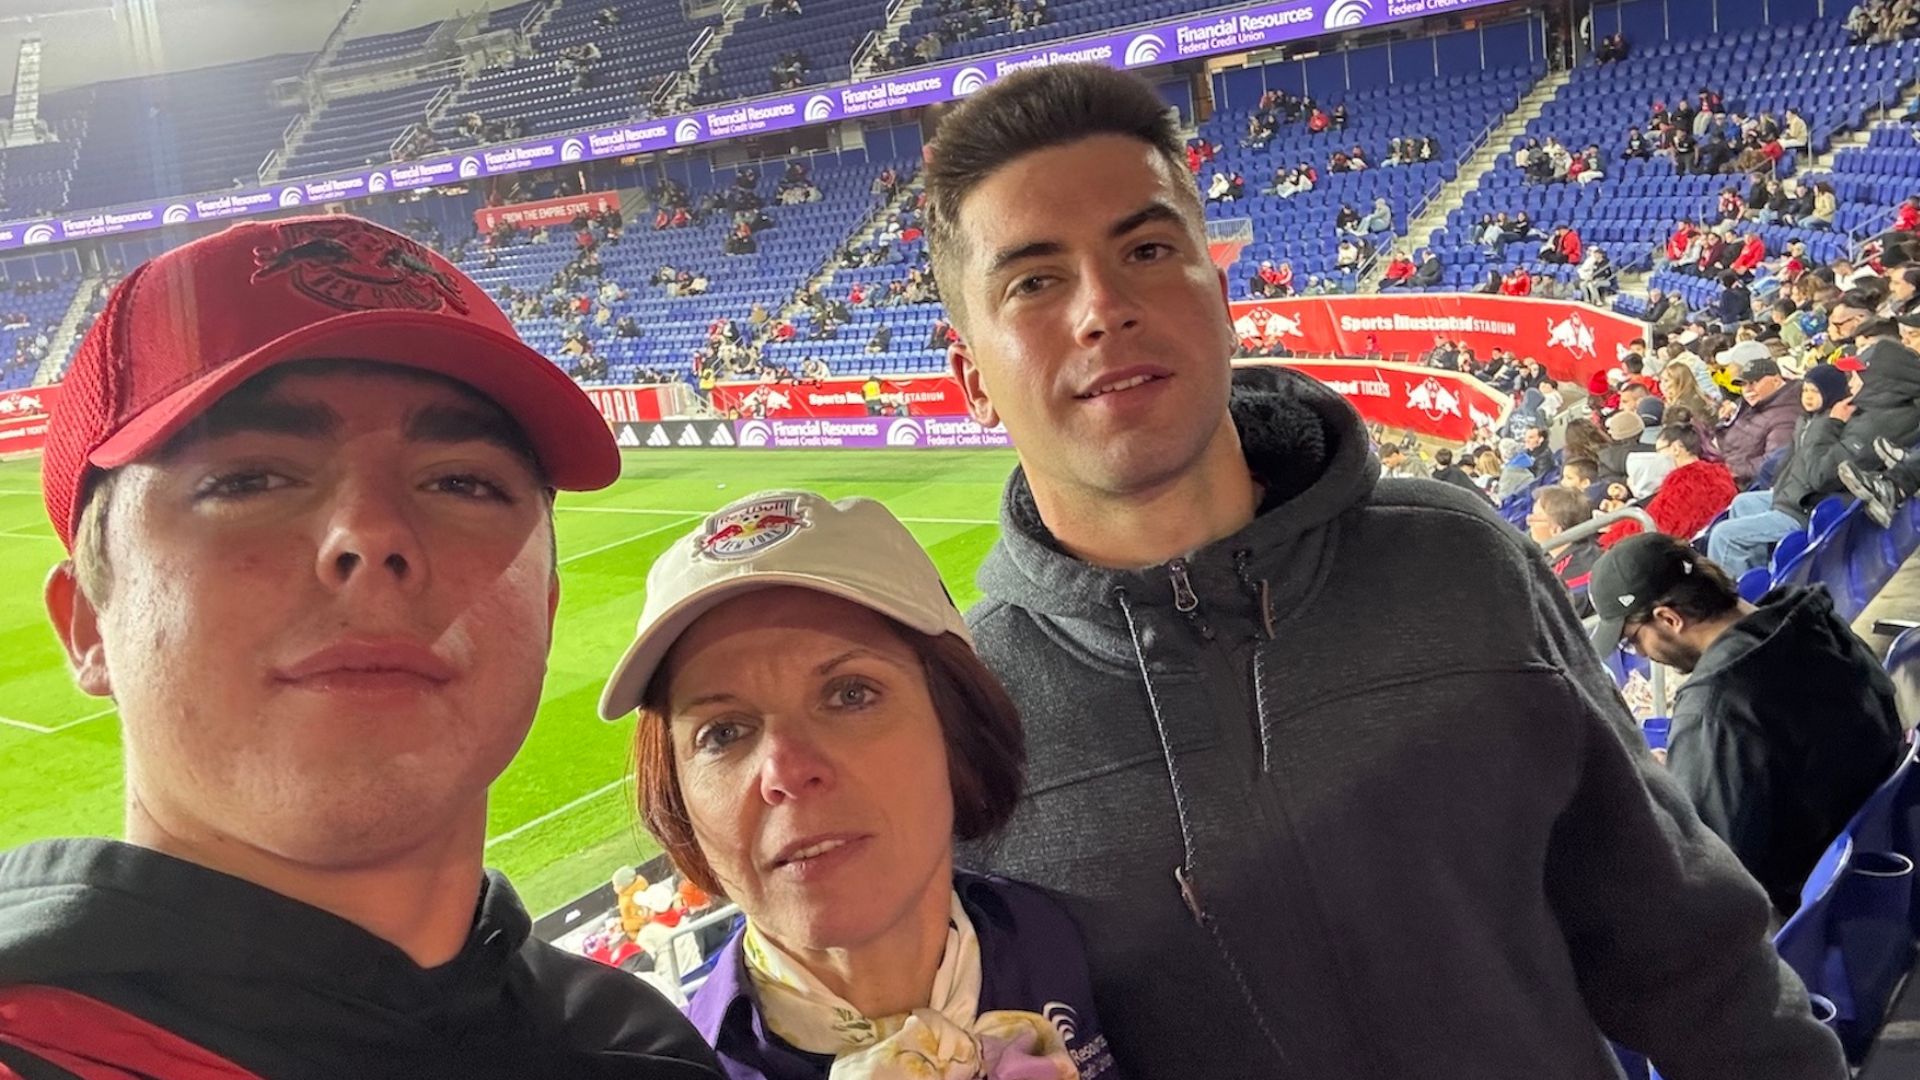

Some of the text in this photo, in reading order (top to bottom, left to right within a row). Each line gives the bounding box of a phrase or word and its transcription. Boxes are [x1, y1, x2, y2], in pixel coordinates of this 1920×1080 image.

[1388, 1, 1425, 16] Federal
[1177, 7, 1313, 43] Financial Resources
[1178, 31, 1265, 54] Federal Credit Union
[841, 78, 942, 105] Financial Resources
[843, 96, 908, 113] Federal Credit Union
[708, 105, 795, 127] Financial Resources
[590, 127, 667, 147] Financial Resources
[709, 122, 765, 136] Federal Credit Union
[485, 146, 554, 165] Financial Resources
[391, 163, 453, 180] Financial Resources
[196, 194, 272, 212] Financial Resources
[63, 211, 153, 231] Financial Resources
[1341, 313, 1516, 336] Sports Illustrated STADIUM
[905, 391, 945, 402] STADIUM
[772, 420, 879, 436] Financial Resources
[775, 436, 843, 446] Federal Credit Union
[926, 434, 1009, 446] Federal Credit Union
